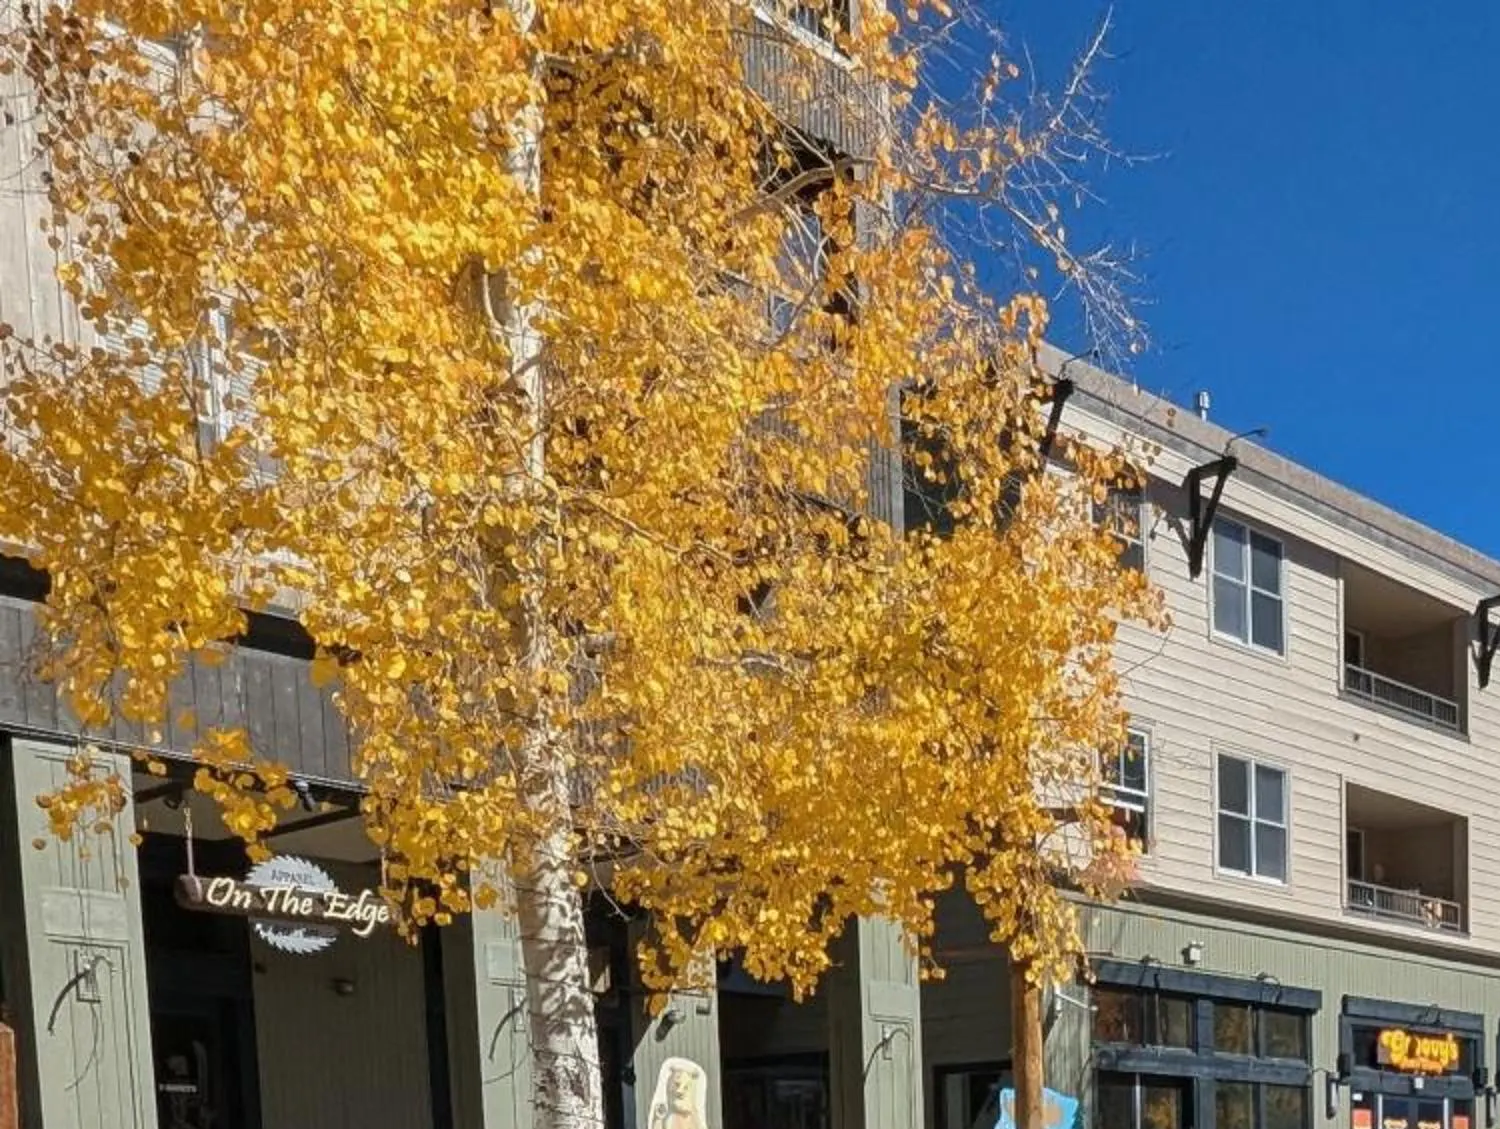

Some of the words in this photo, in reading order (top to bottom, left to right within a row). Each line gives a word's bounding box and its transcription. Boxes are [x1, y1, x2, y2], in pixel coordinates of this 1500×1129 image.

[206, 877, 251, 909] On
[260, 884, 313, 915] The
[323, 889, 390, 938] Edge
